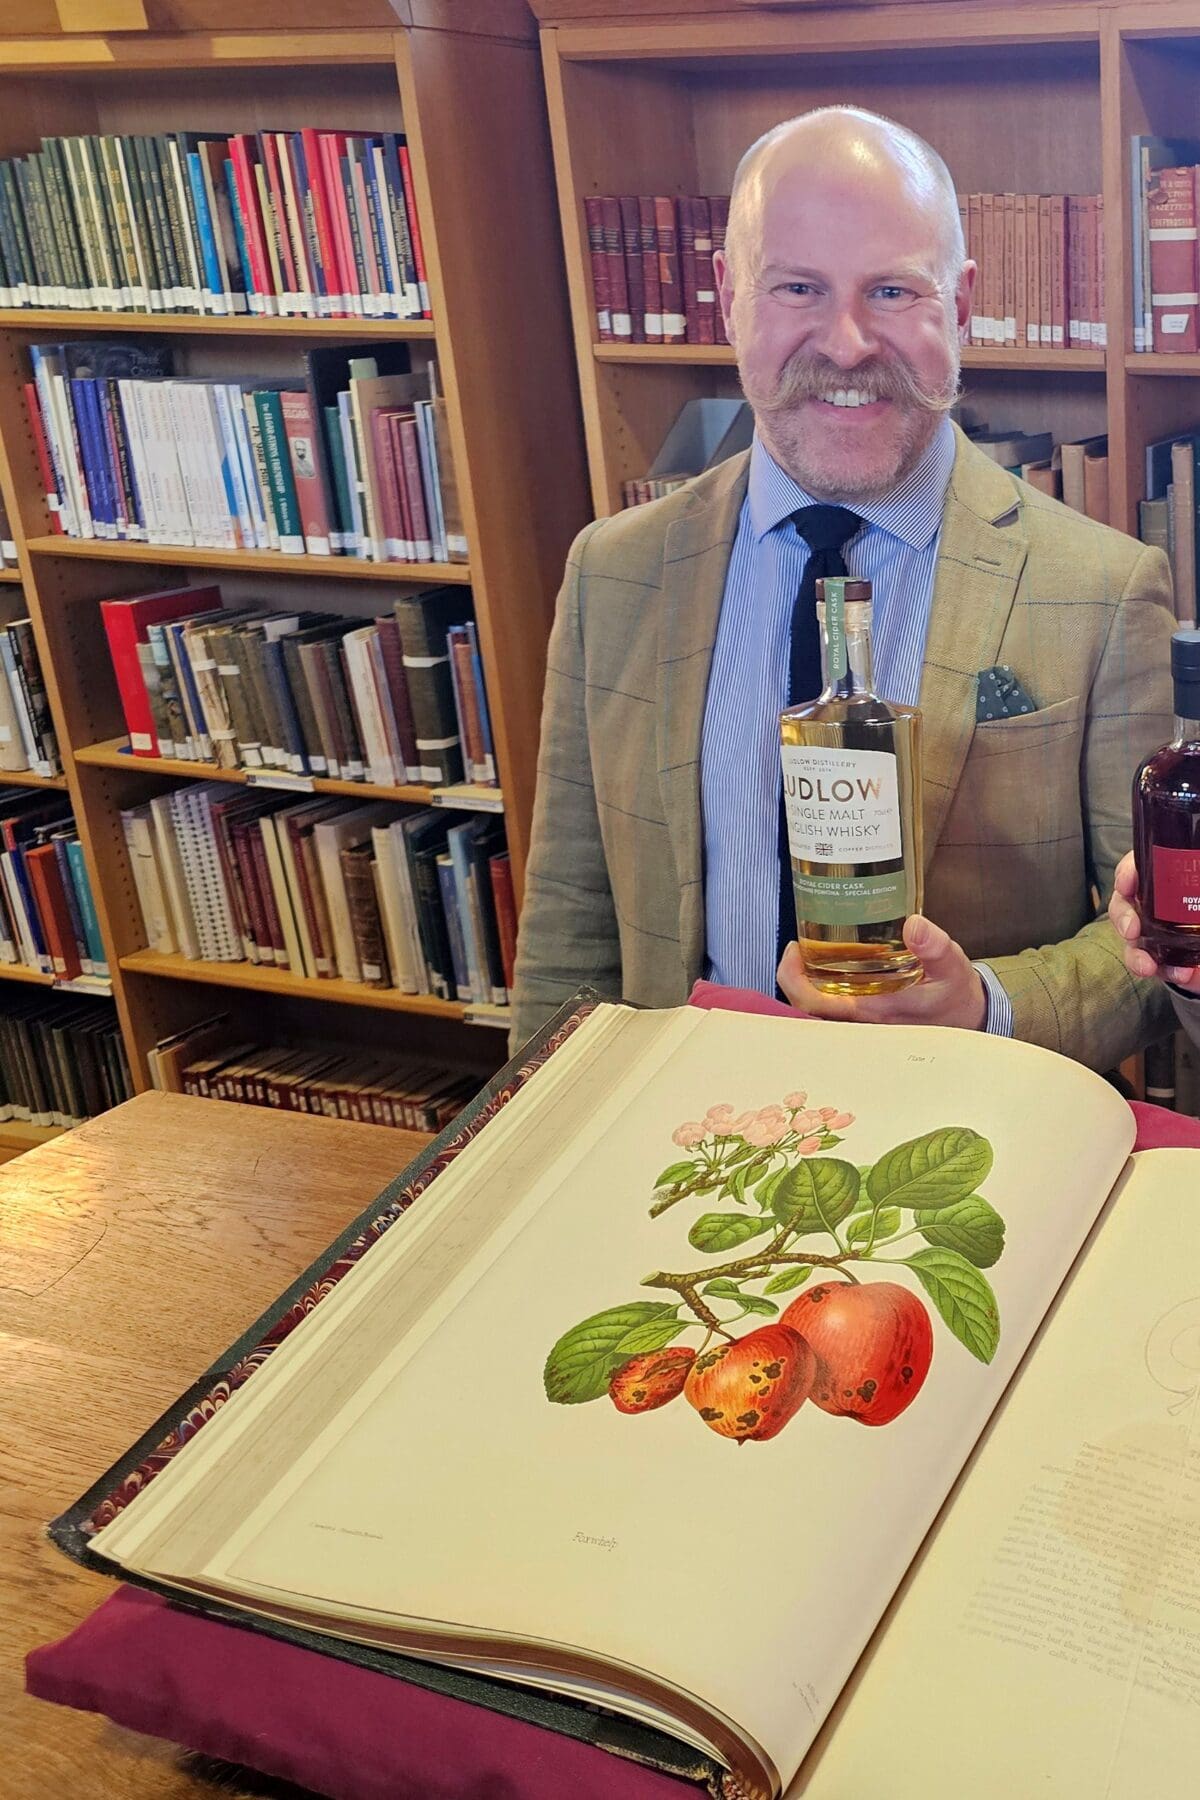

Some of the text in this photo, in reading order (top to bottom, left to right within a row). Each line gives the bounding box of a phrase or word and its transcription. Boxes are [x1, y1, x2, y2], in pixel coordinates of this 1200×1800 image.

[812, 759, 856, 768] DISTILLERY
[830, 809, 865, 820] MALT
[826, 824, 880, 837] WHISKY
[799, 878, 816, 888] ROYAL
[818, 882, 841, 890] CIDER
[873, 886, 897, 894] EDITION
